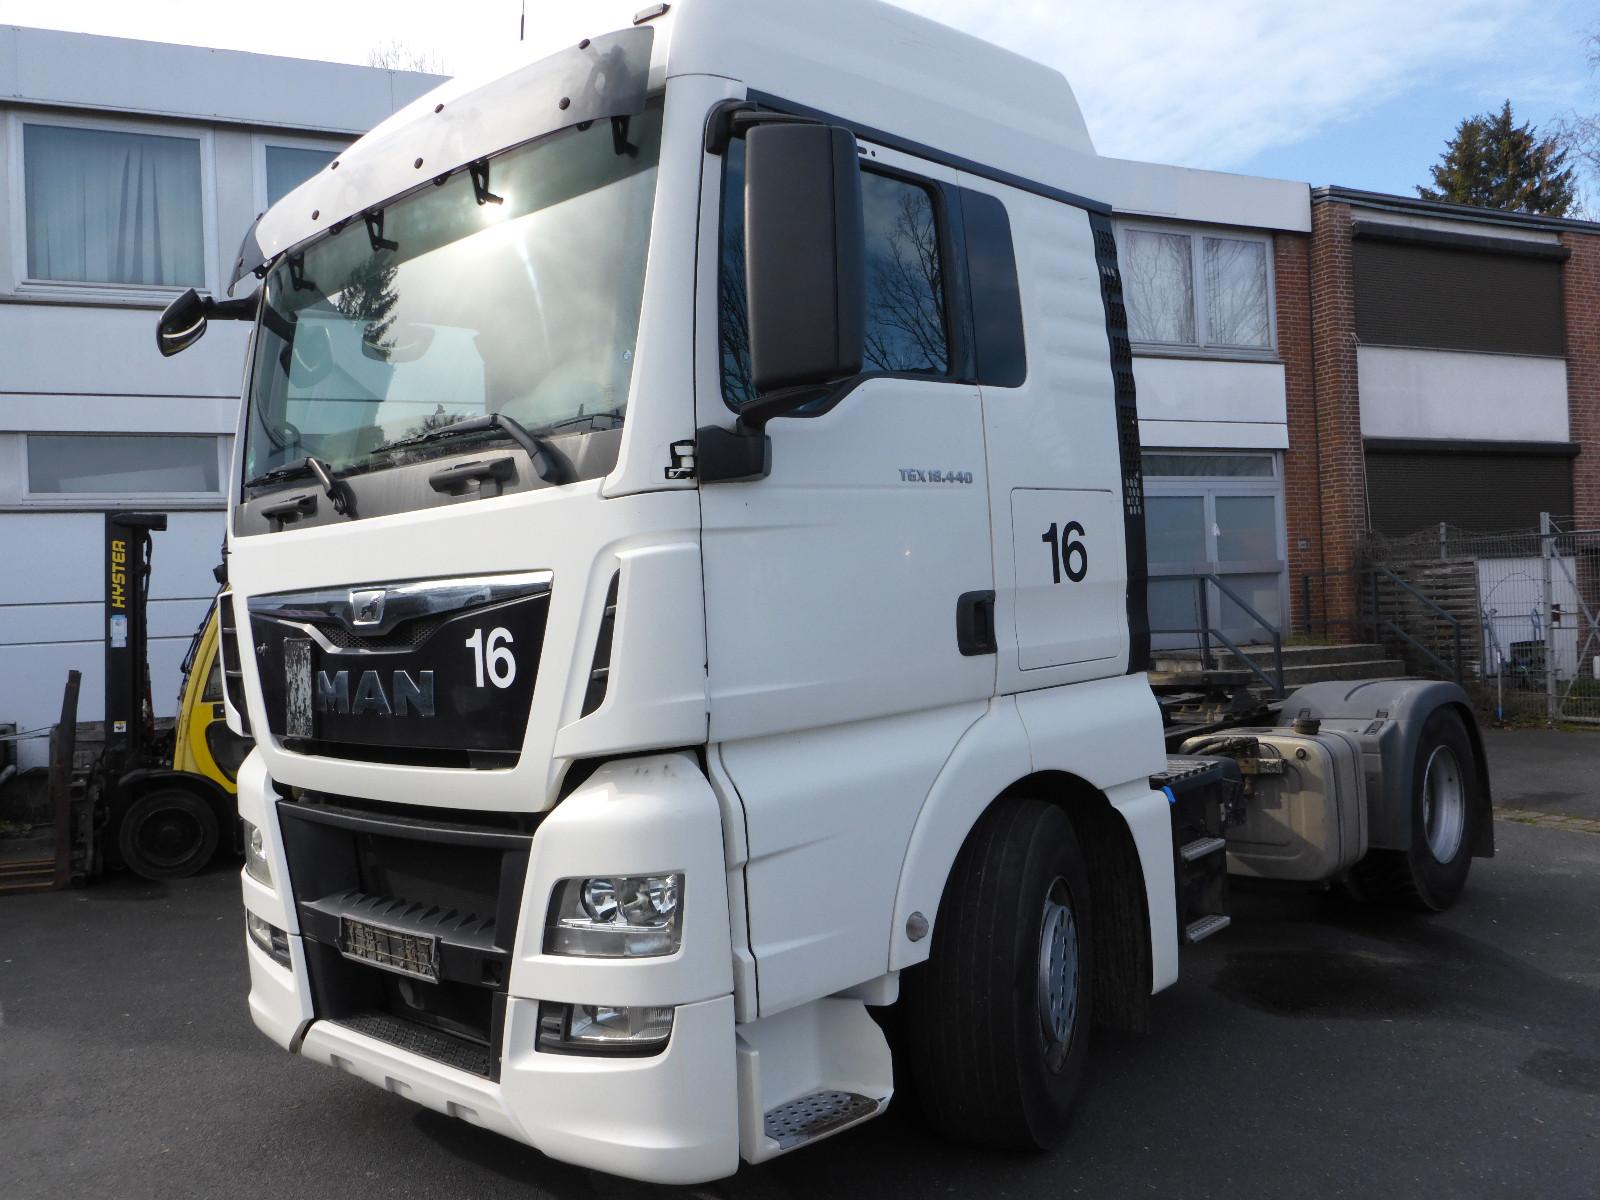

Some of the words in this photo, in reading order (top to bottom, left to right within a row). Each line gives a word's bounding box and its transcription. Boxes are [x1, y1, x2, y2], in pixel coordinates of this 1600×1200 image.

[899, 469, 926, 482] TGX
[928, 470, 973, 484] 18.440
[112, 540, 126, 608] HYSTER
[1041, 520, 1087, 584] 16
[465, 627, 517, 688] 16
[318, 670, 435, 717] MAN
